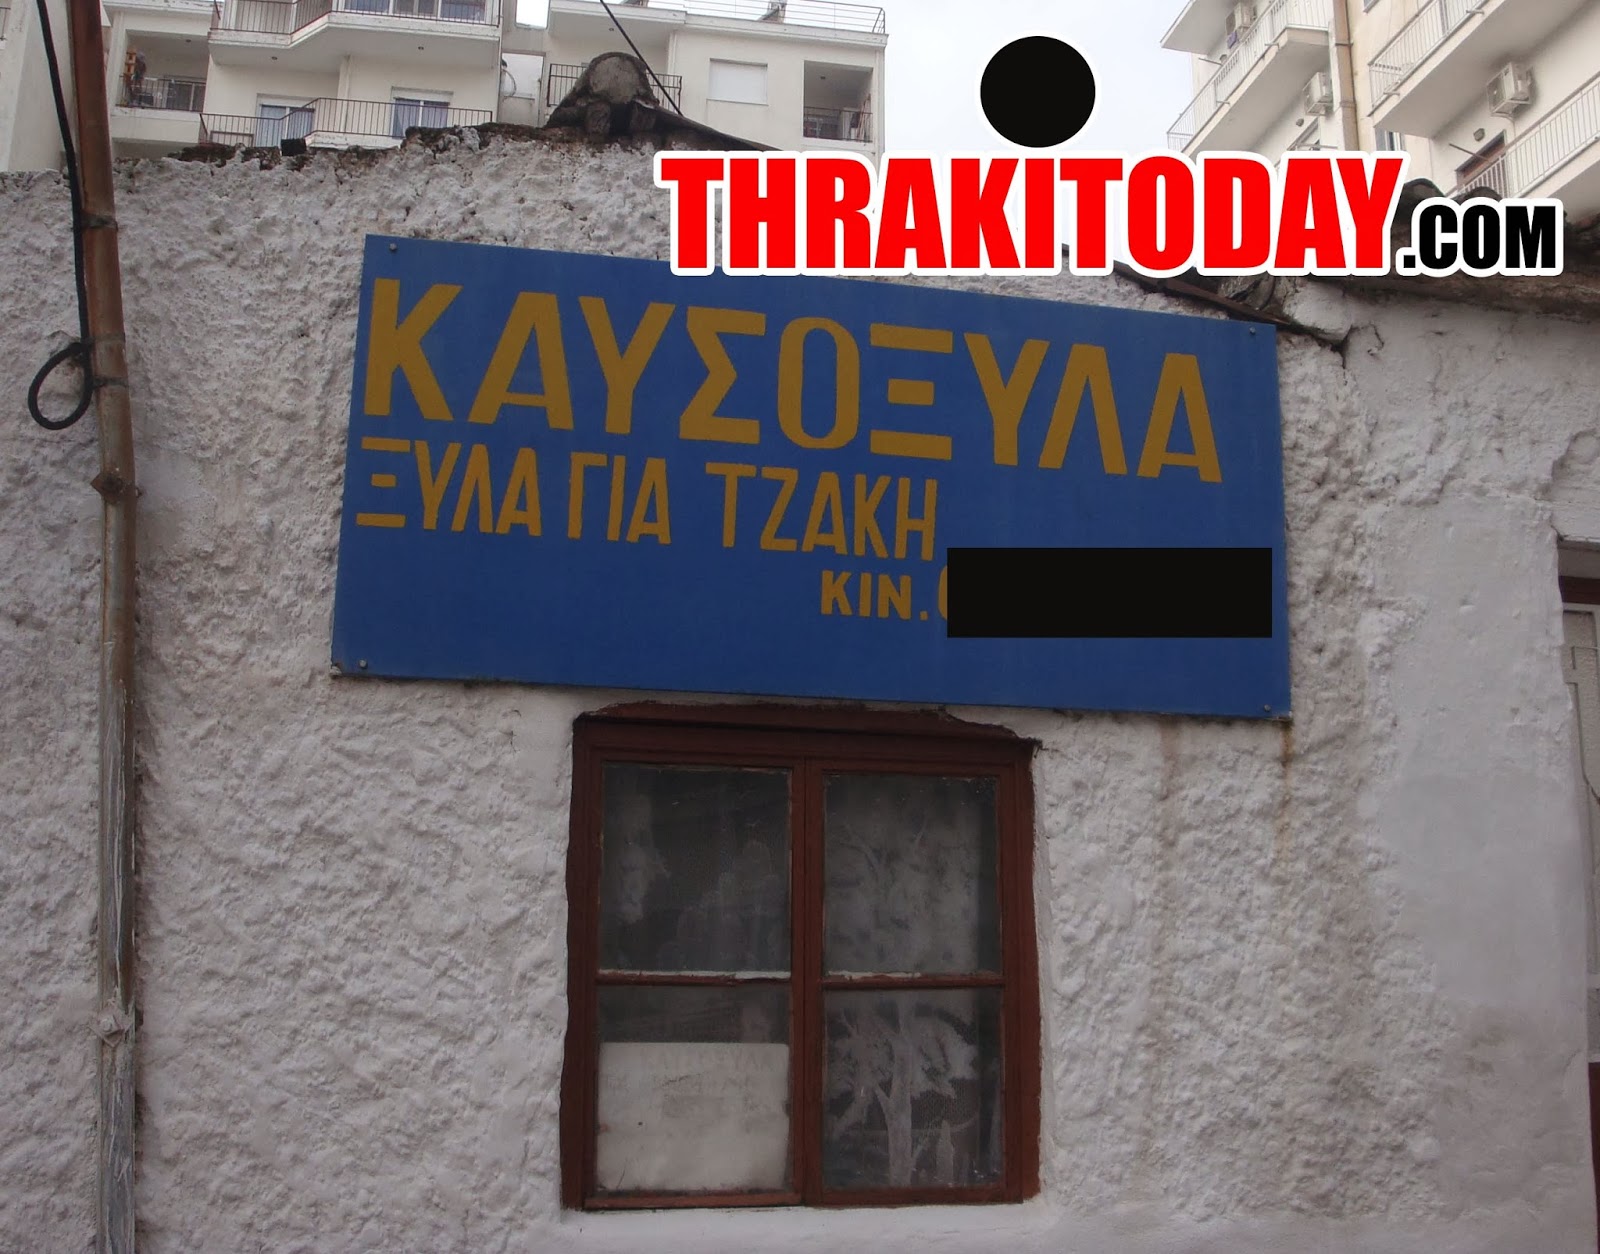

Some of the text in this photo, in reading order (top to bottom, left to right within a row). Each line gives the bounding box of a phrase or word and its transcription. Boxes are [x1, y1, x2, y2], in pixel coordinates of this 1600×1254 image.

[363, 277, 1223, 484] ΚΑΥΣΟΞΥΛΑ
[355, 436, 938, 561] ΞΥΛΑ ΓΙΑ ΤΖΑΚΗ
[820, 569, 929, 621] ΚΙΝ.
